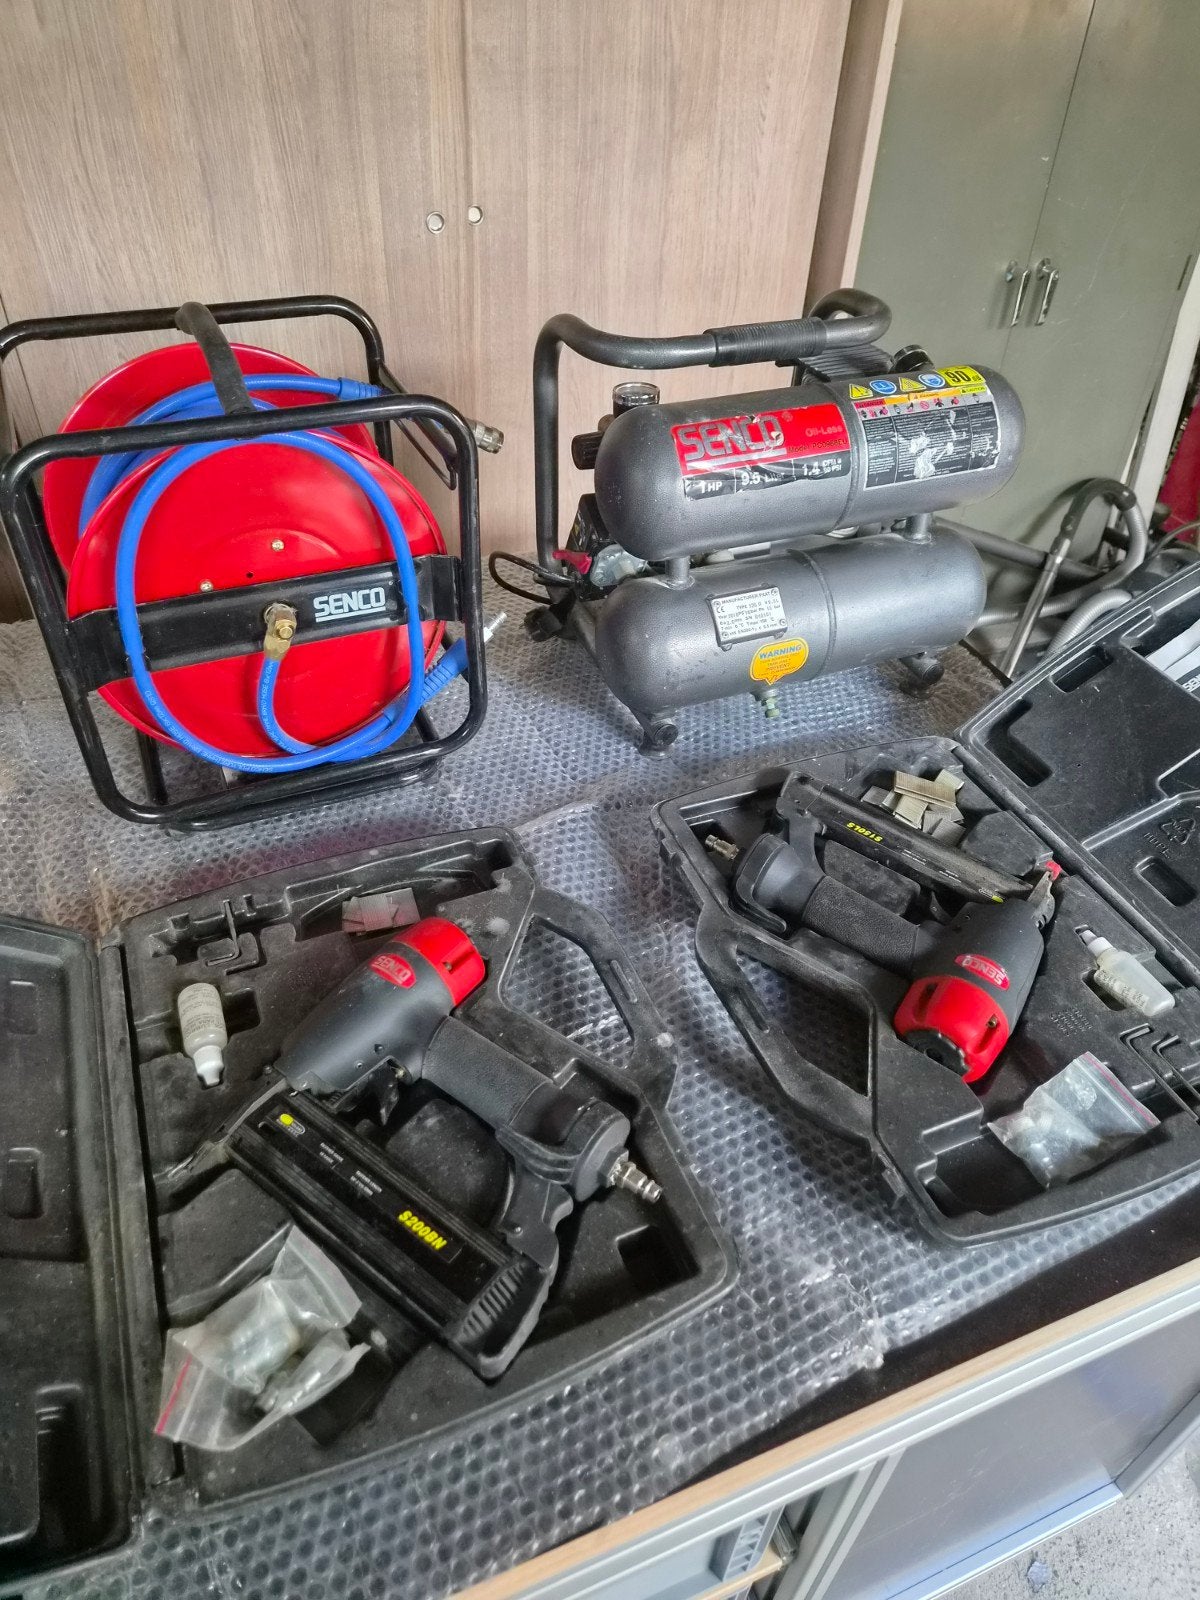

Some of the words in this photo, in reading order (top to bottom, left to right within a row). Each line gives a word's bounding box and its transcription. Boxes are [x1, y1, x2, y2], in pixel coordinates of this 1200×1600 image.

[944, 370, 972, 383] 90
[677, 415, 785, 462] SENCO
[707, 481, 723, 493] HP
[741, 472, 761, 486] 9.5
[313, 587, 386, 618] SENCO
[759, 645, 802, 660] WARNING
[846, 821, 884, 843] S150LS
[373, 955, 412, 983] SENCO
[961, 955, 1006, 985] SENCO
[398, 1210, 448, 1250] S200BN
